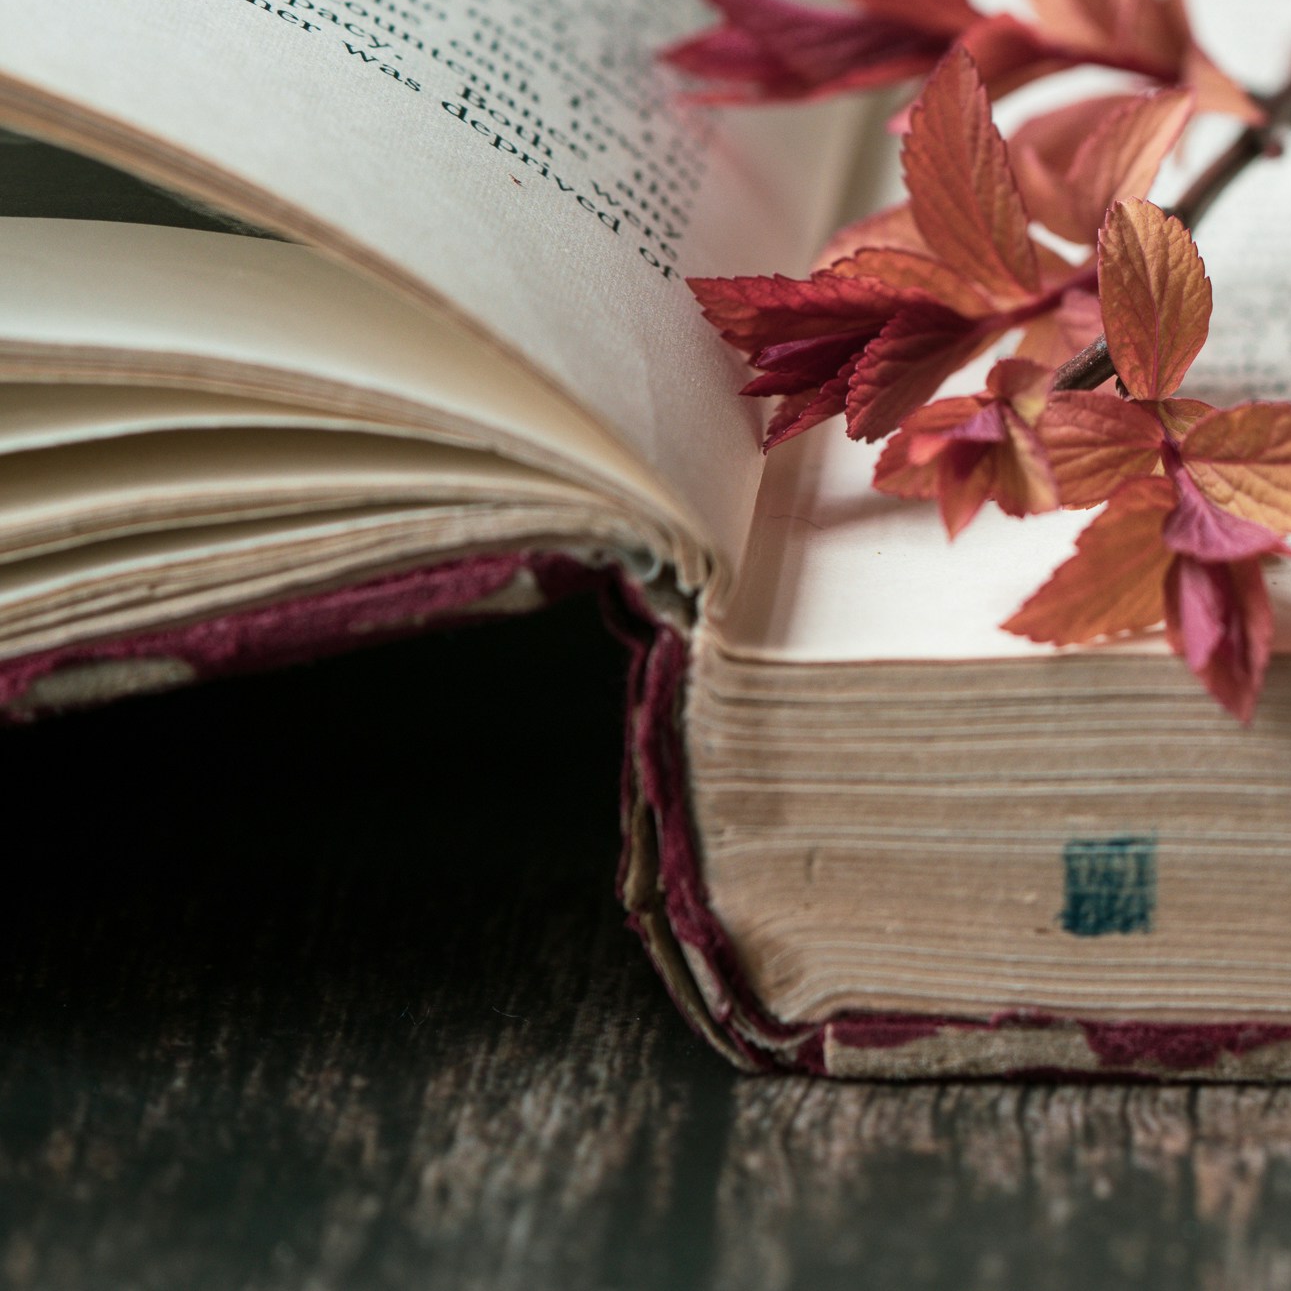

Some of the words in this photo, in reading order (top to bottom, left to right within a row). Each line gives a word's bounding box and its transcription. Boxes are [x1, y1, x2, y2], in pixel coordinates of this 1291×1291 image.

[342, 40, 421, 92] was
[440, 100, 621, 236] deprived
[638, 246, 680, 281] of
[448, 39, 541, 105] oath
[569, 119, 607, 153] to
[459, 85, 552, 159] Both
[591, 180, 679, 264] were
[615, 180, 685, 241] any
